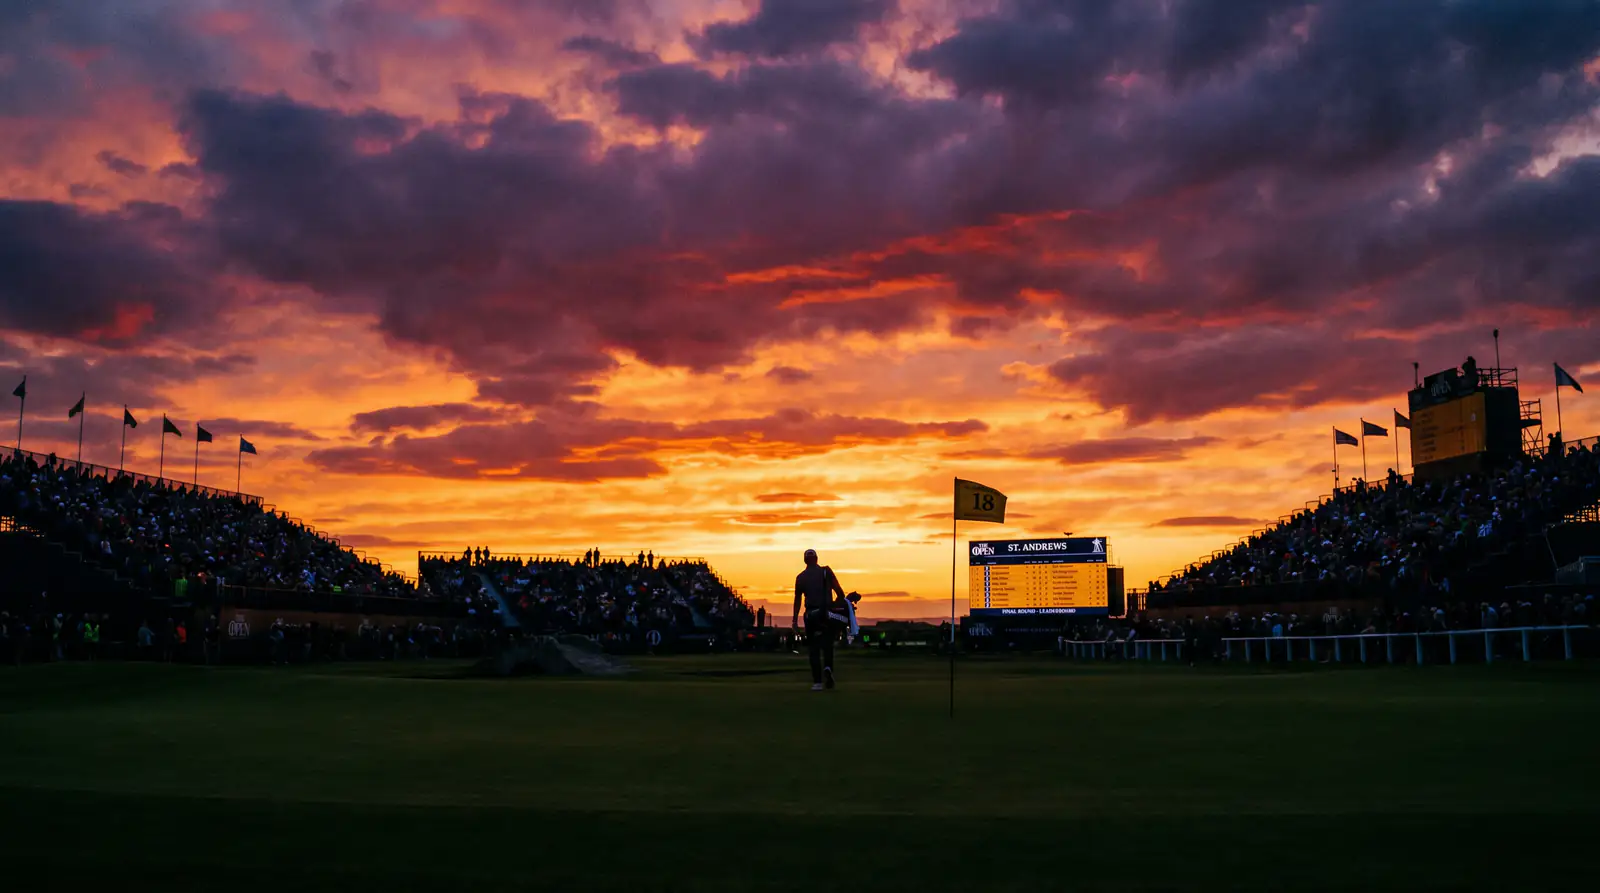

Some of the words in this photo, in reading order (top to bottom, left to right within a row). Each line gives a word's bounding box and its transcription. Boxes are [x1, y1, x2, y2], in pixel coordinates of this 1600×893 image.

[972, 492, 994, 511] 18
[972, 546, 995, 555] OPEN
[1008, 543, 1021, 552] ST.
[1022, 542, 1067, 551] ANDREWS
